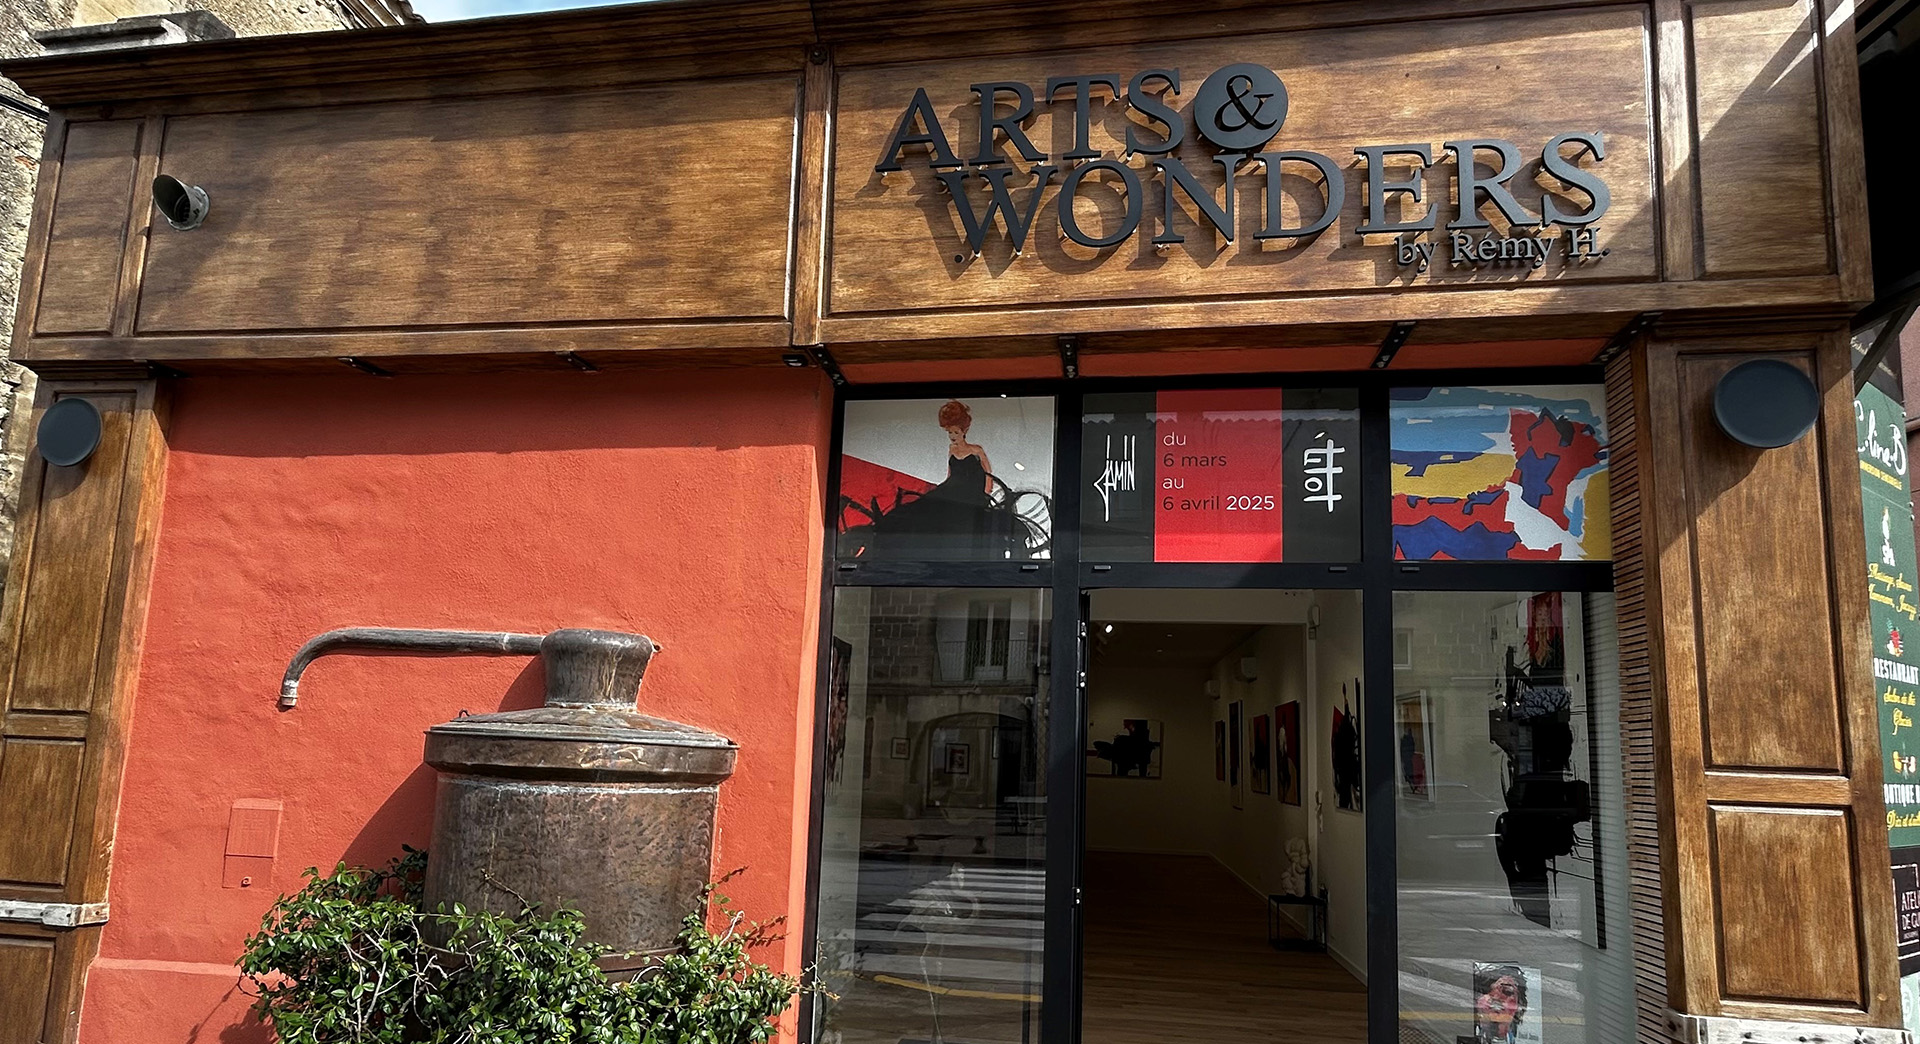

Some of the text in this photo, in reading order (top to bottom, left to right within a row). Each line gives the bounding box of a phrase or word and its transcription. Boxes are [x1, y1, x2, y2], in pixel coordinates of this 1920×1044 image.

[875, 67, 1282, 172] ARTS &
[937, 130, 1612, 257] WONDERS
[1394, 227, 1611, 275] by Rémy H.
[1163, 432, 1187, 446] du
[1163, 453, 1228, 467] 6 mars
[1163, 477, 1185, 489] au
[1163, 496, 1275, 511] 6 avril 2025
[1873, 657, 1919, 686] RESTAURANT
